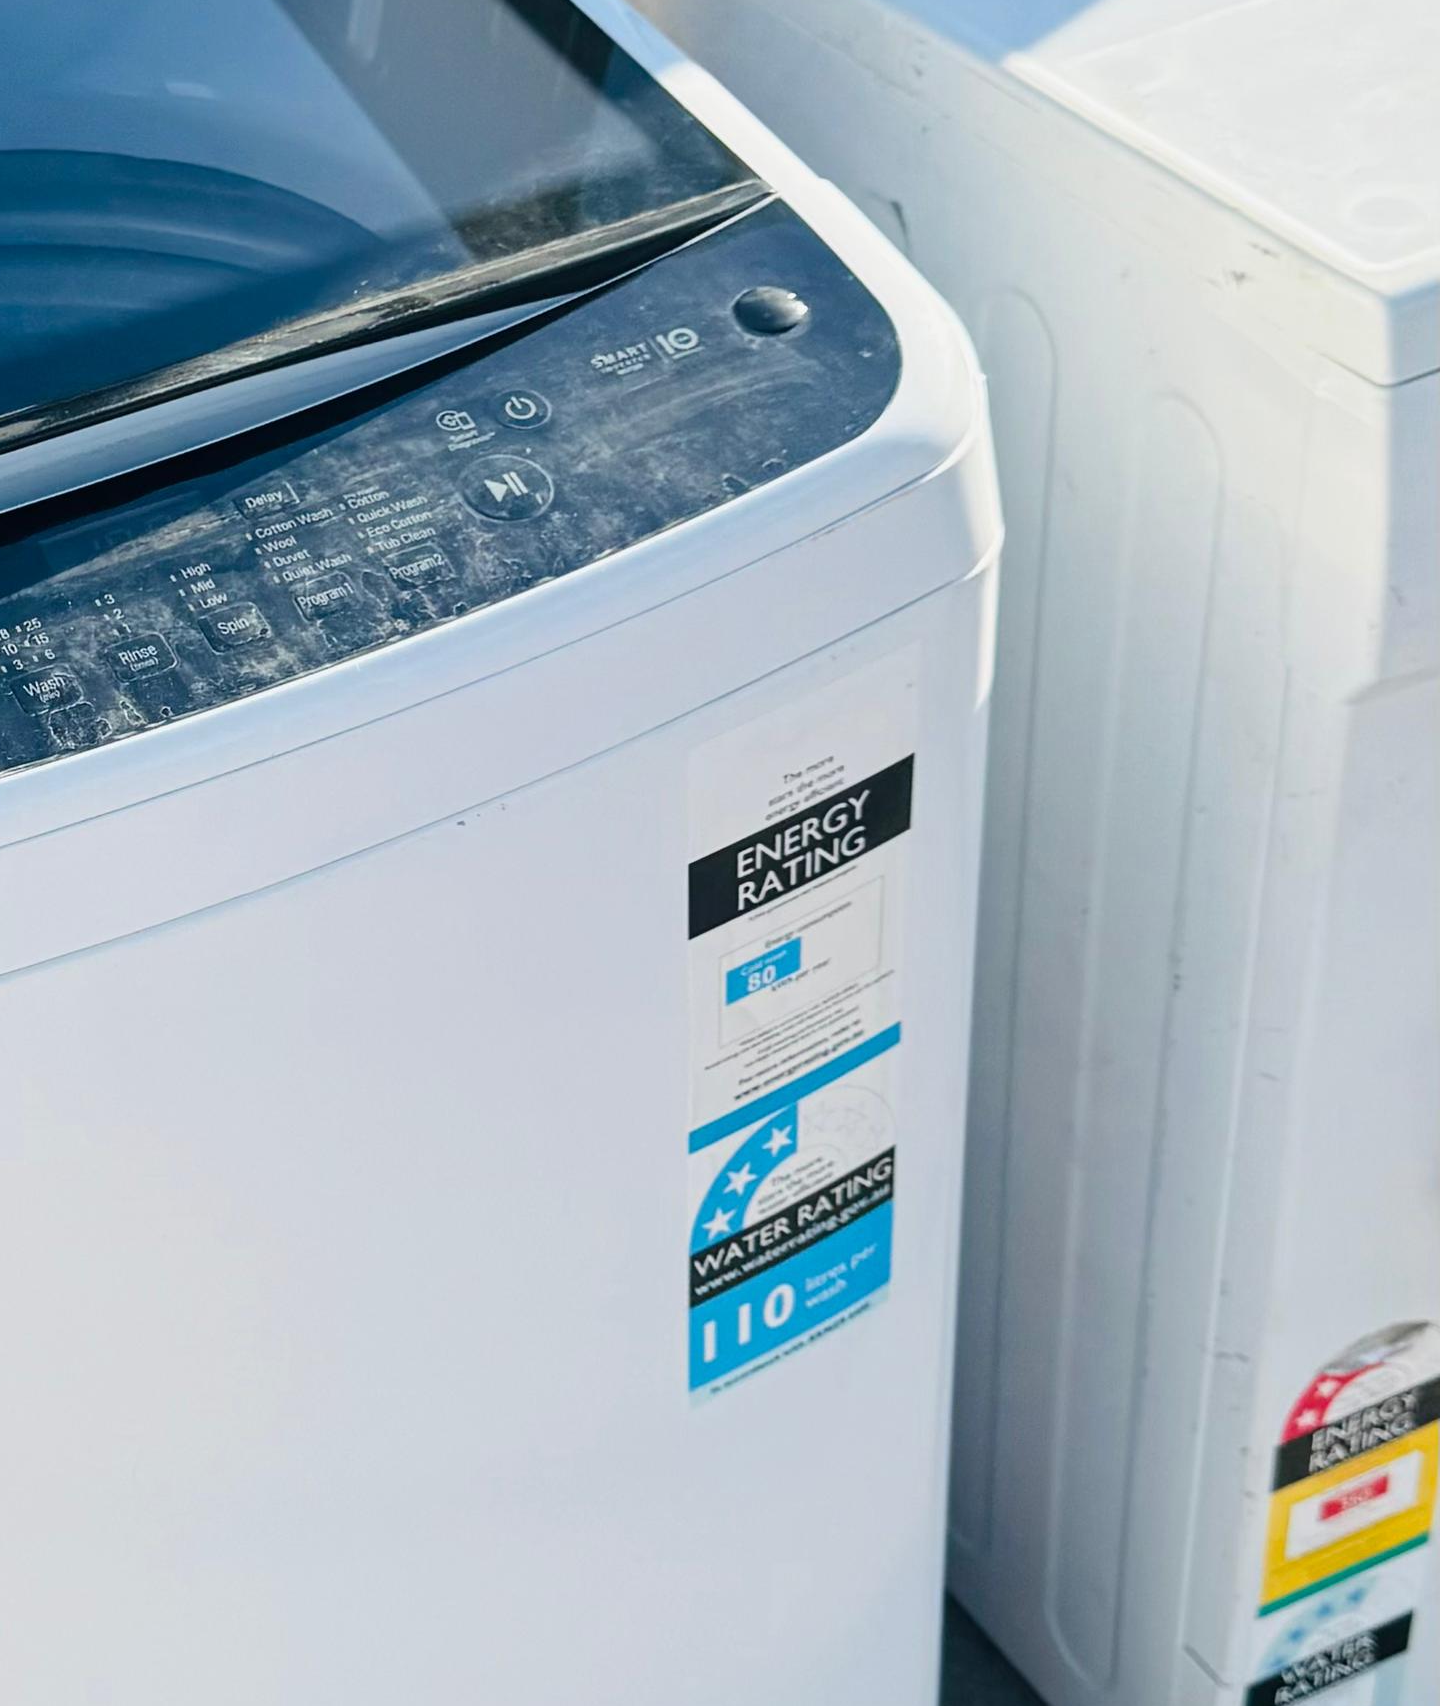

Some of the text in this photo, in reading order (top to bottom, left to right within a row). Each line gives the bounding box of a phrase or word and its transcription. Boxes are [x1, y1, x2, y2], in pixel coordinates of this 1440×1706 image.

[590, 342, 647, 369] SMART
[244, 491, 284, 510] Delay
[347, 491, 390, 509] Cotton
[357, 495, 428, 524] Quick Wash
[255, 507, 334, 539] Cotton Wash
[366, 511, 432, 538] Eco Cotton
[262, 535, 298, 554] Wool
[375, 527, 436, 552] Tub Clean
[180, 561, 212, 580] High
[272, 549, 311, 568] Duvet
[283, 553, 352, 583] Quiet Wash
[190, 578, 216, 595] Mid
[104, 594, 115, 605] 3
[199, 593, 228, 609] Low
[23, 617, 42, 632] 25
[113, 608, 125, 620] 2
[217, 616, 250, 635] Spin
[1, 632, 50, 657] 10 15
[118, 644, 159, 665] Rinse
[13, 648, 56, 671] 3 6
[22, 673, 66, 697] Wash
[737, 789, 871, 878] ENERGY
[737, 826, 866, 911] RATING
[746, 964, 777, 993] 80
[693, 1156, 892, 1277] WATER RATING
[703, 1283, 796, 1363] 110
[1311, 1394, 1417, 1452] ENERGY
[1309, 1411, 1417, 1472] RATING
